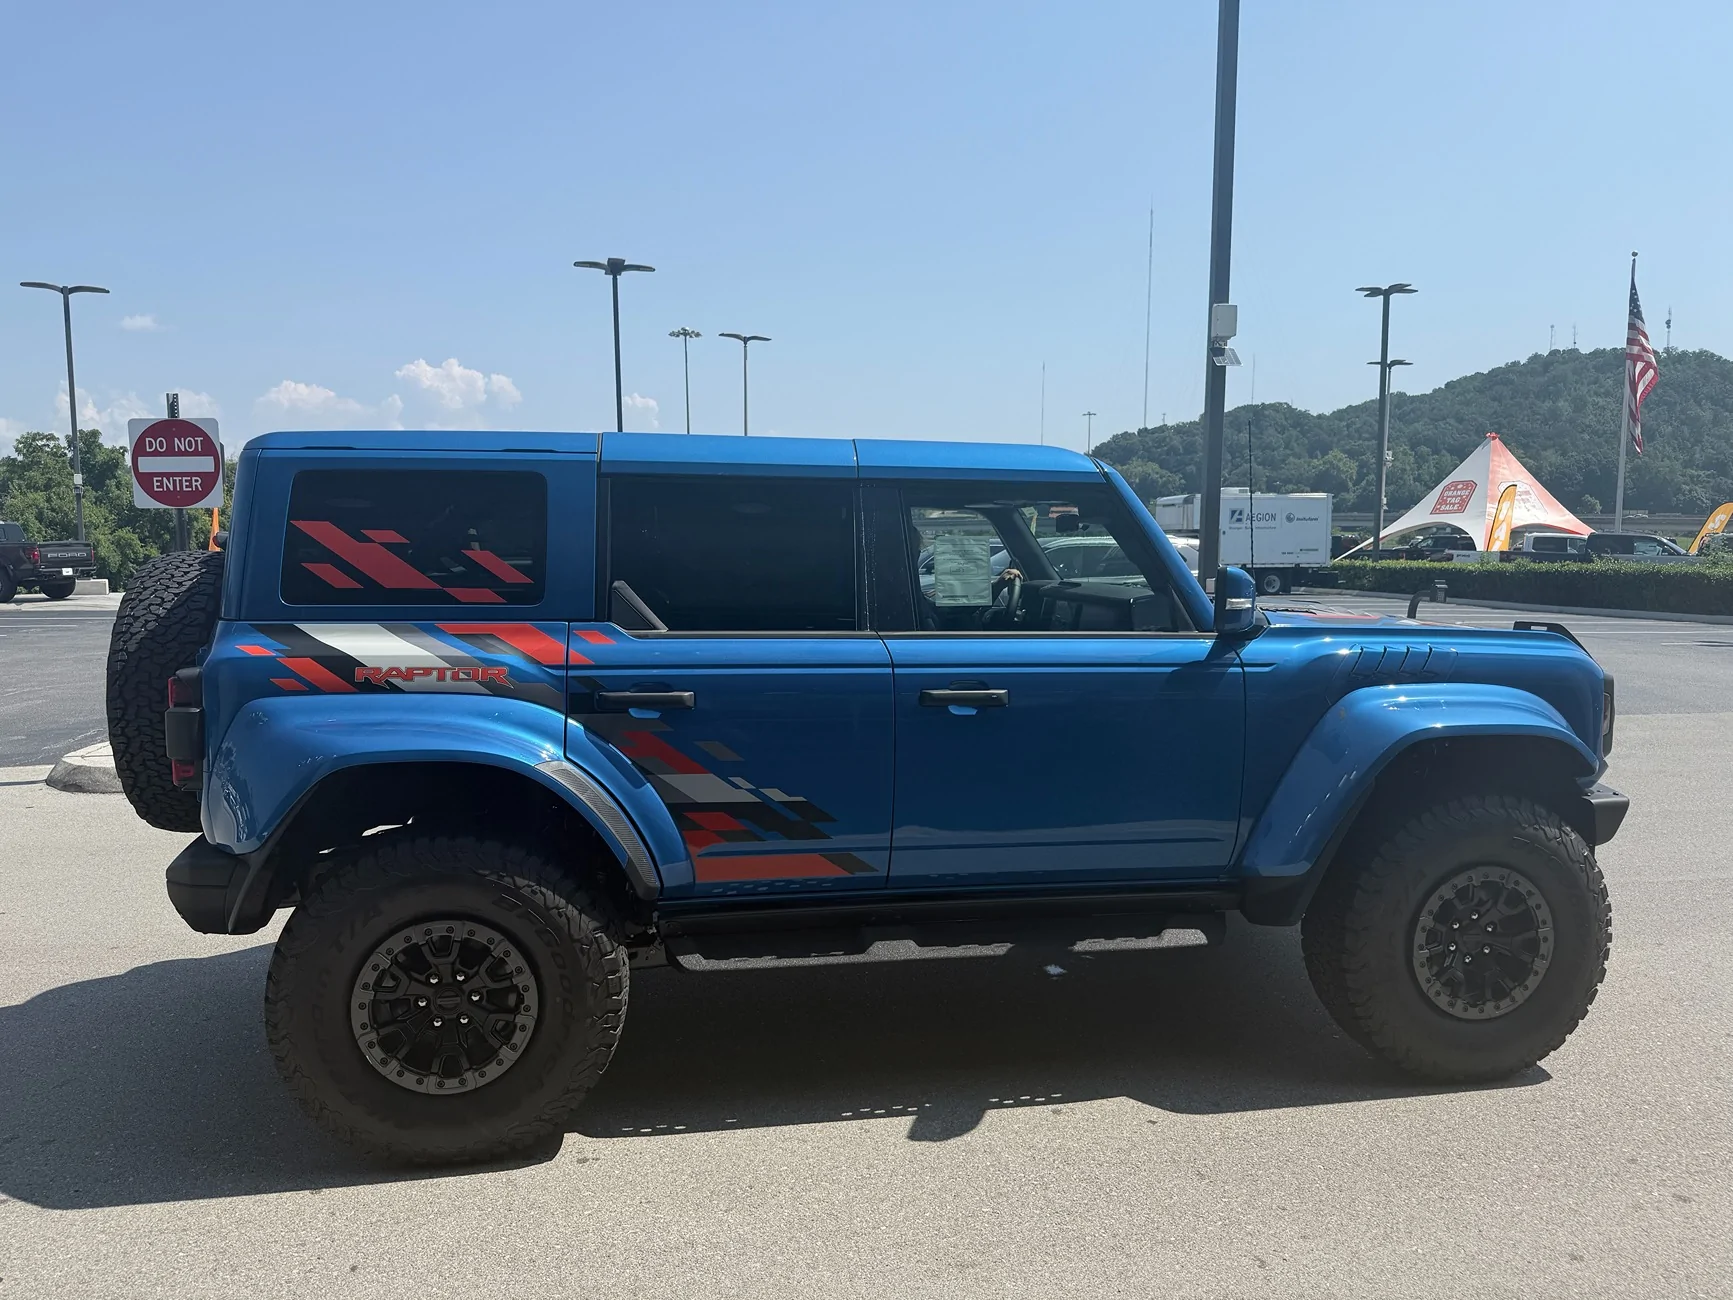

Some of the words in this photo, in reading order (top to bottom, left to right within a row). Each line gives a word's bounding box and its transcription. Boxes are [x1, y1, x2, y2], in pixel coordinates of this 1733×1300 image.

[145, 437, 167, 452] DO
[174, 437, 204, 452] NOT
[153, 476, 203, 491] ENTER
[1245, 512, 1277, 522] AEGION
[355, 666, 514, 689] RAPTOR
